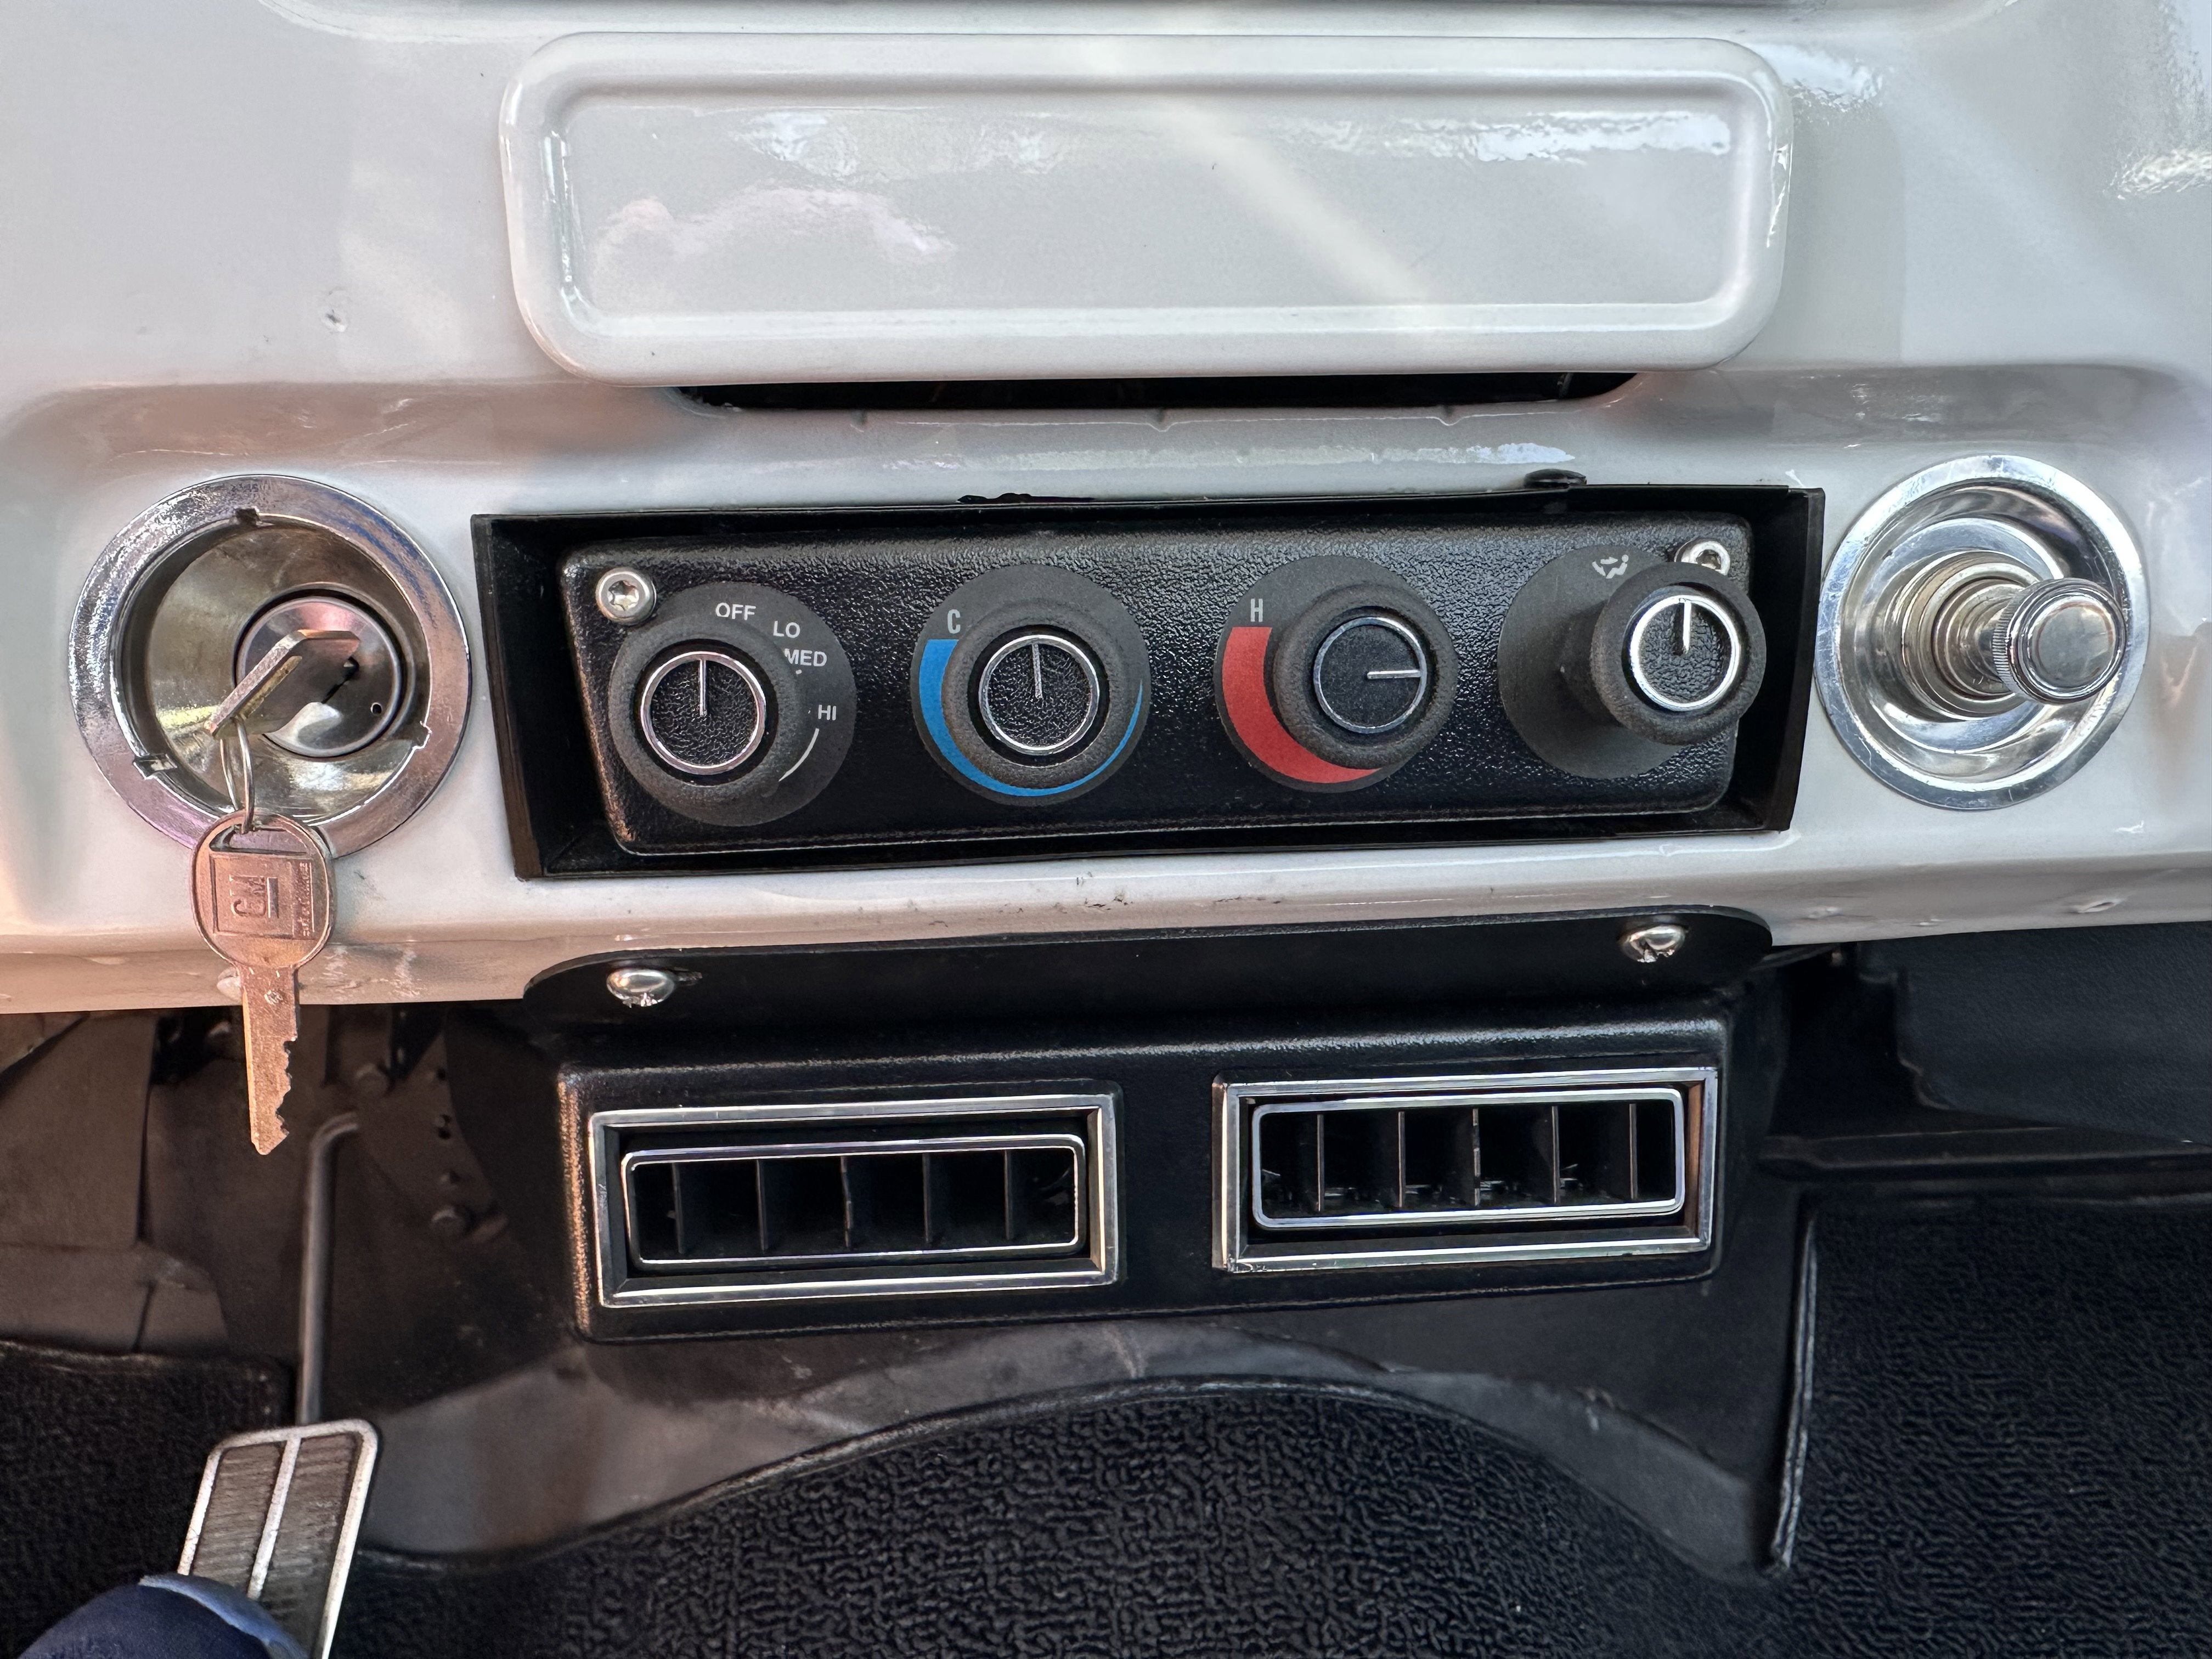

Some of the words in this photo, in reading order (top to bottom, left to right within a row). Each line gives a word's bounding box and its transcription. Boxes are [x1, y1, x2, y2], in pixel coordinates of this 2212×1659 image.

[714, 602, 757, 621] OFF
[1250, 598, 1263, 623] H
[772, 620, 801, 639] LO
[947, 608, 961, 634] C
[783, 648, 827, 667] MED
[817, 704, 837, 721] HI
